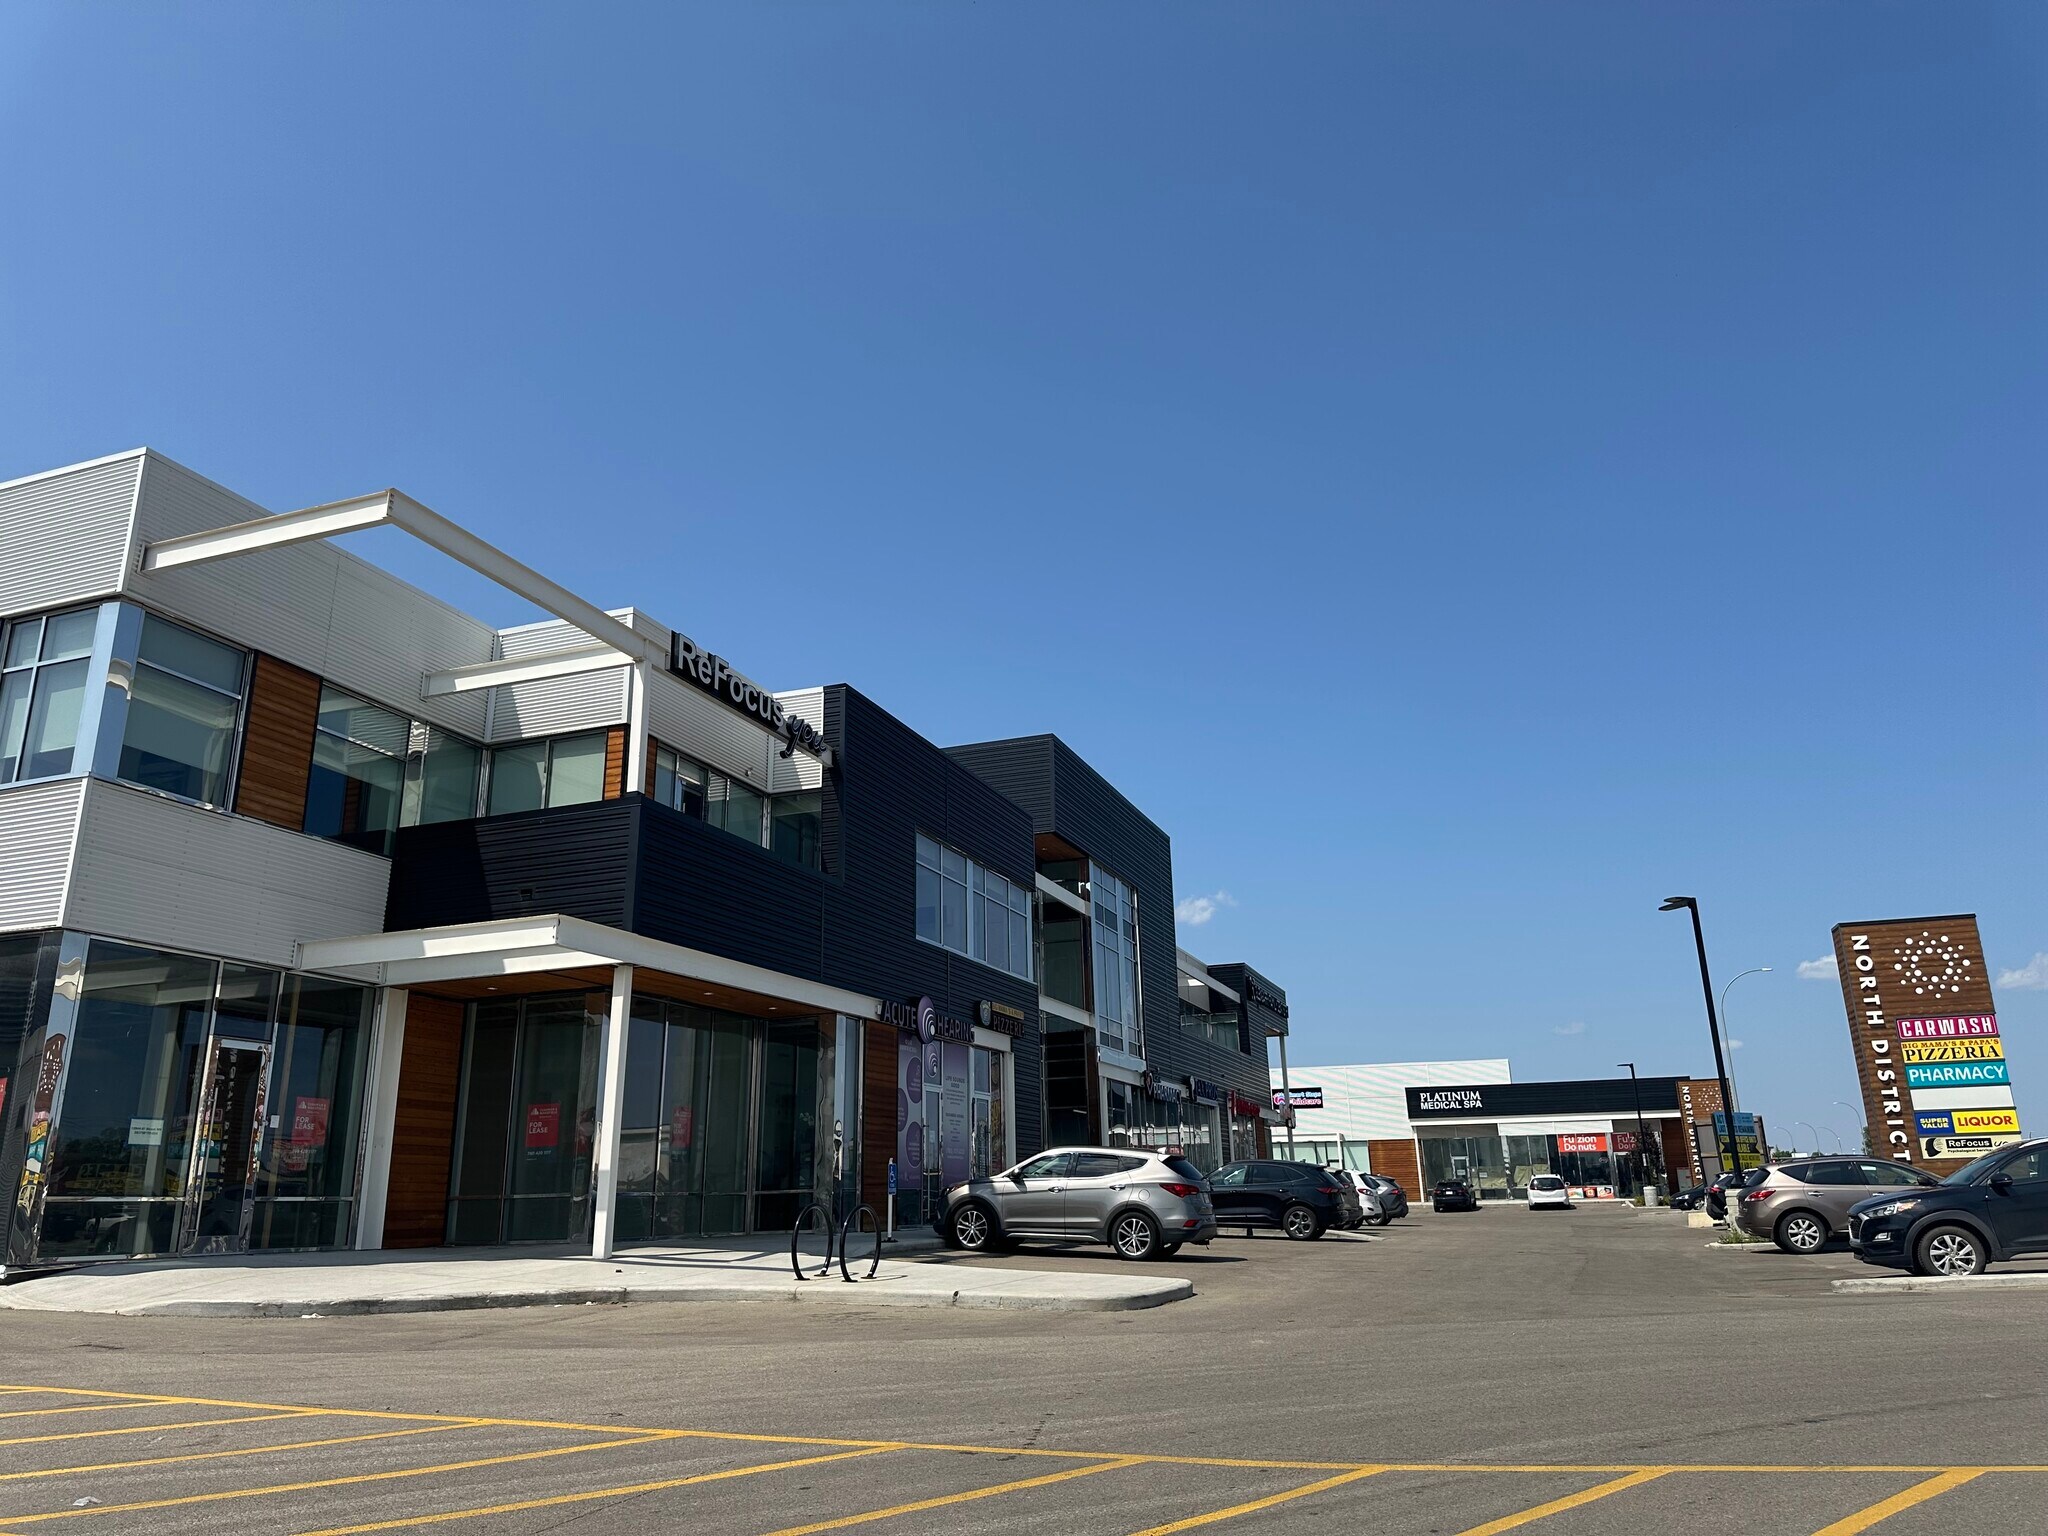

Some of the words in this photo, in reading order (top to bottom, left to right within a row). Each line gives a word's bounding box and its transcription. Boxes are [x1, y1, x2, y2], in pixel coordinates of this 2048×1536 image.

[677, 634, 785, 727] ReFocus
[779, 715, 826, 758] you
[884, 999, 916, 1029] ACUTE
[937, 1014, 975, 1042] HEARING
[1901, 1017, 1993, 1037] CARWASH
[1851, 935, 1885, 1025] NORTH
[1871, 1040, 1911, 1163] DISTRICT
[1904, 1045, 2000, 1061] PIZZERIA
[1909, 1065, 2004, 1083] PHARMACY
[1419, 1091, 1481, 1102] PLATINUM
[1421, 1102, 1462, 1110] MEDICAL
[1463, 1100, 1483, 1109] SPA
[1682, 1086, 1695, 1124] NORTH
[1958, 1115, 2013, 1127] LIQUOR
[1563, 1135, 1597, 1145] Fuzion
[1564, 1143, 1597, 1151] Donuts
[1617, 1135, 1637, 1143] Fuz
[1948, 1139, 1990, 1148] ReFocus
[1688, 1129, 1703, 1180] DISTRICT
